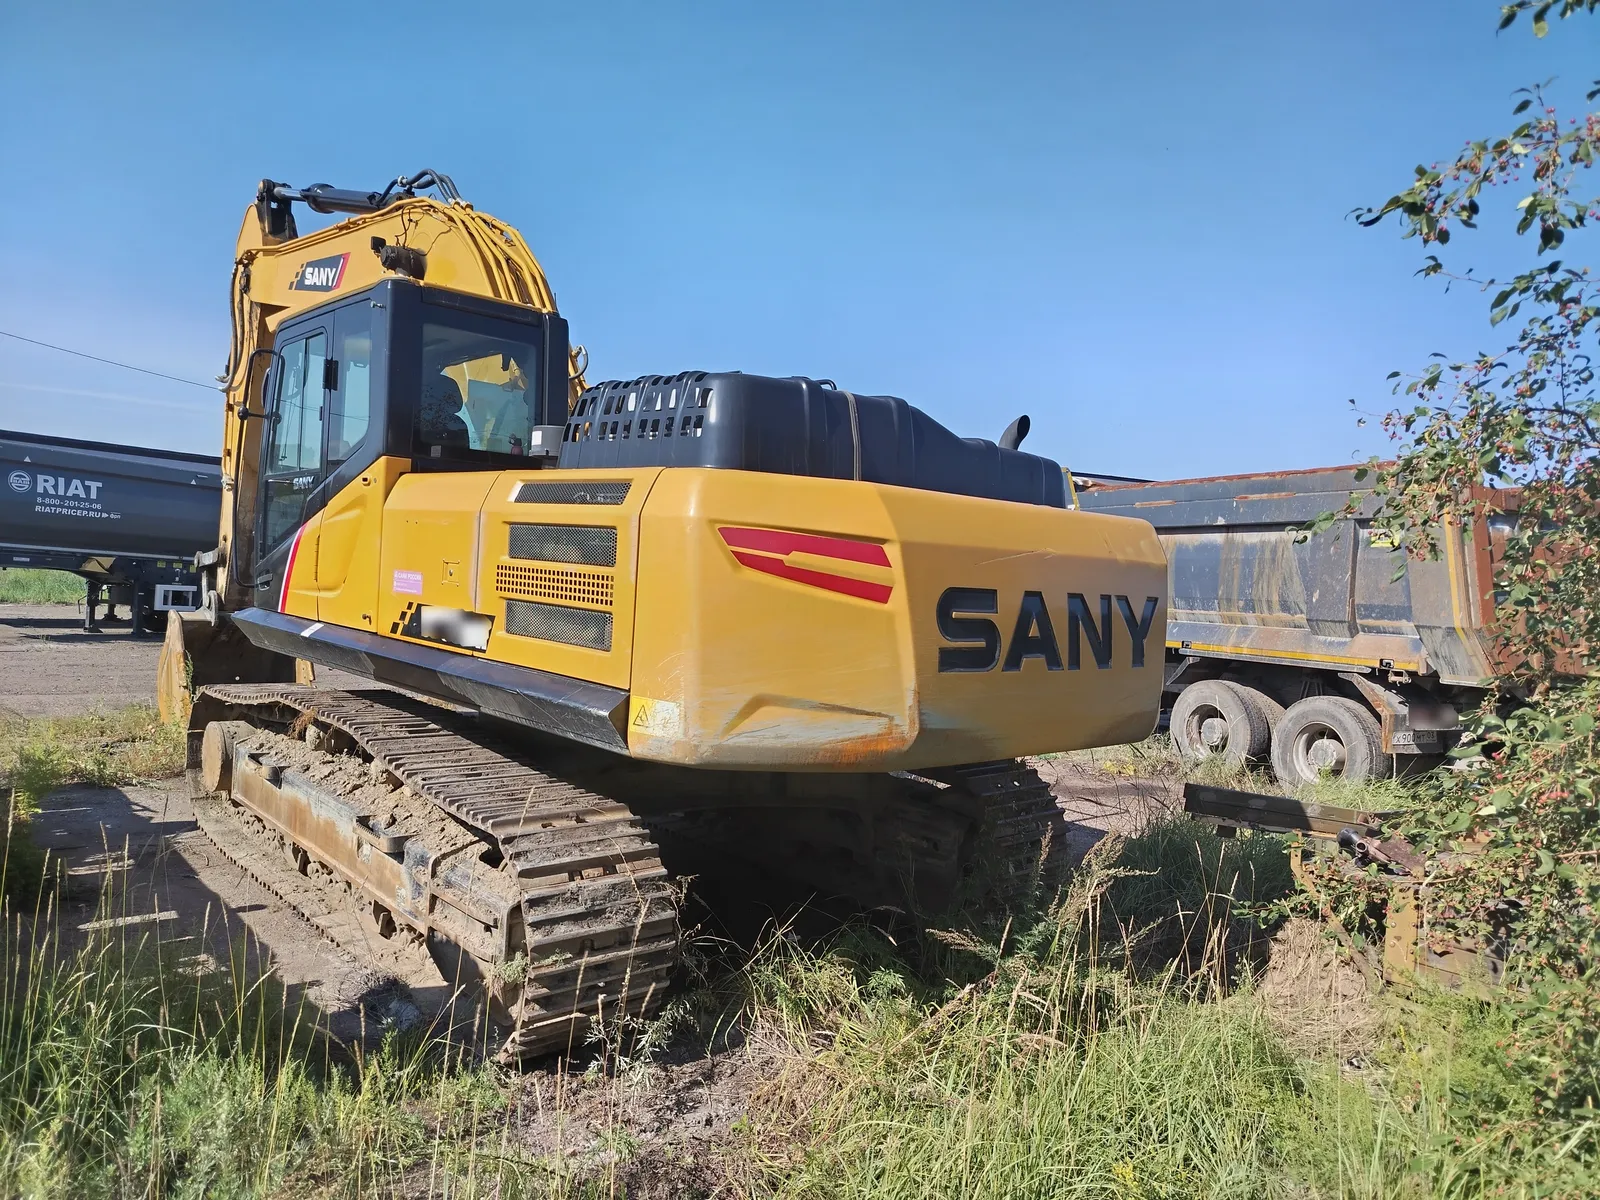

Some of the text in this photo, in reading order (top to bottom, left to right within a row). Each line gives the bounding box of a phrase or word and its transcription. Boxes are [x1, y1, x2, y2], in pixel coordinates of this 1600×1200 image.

[304, 267, 336, 287] SANY
[36, 474, 102, 499] RIAT
[35, 505, 101, 518] RIATPRICEP.RU
[936, 587, 1159, 673] SANY
